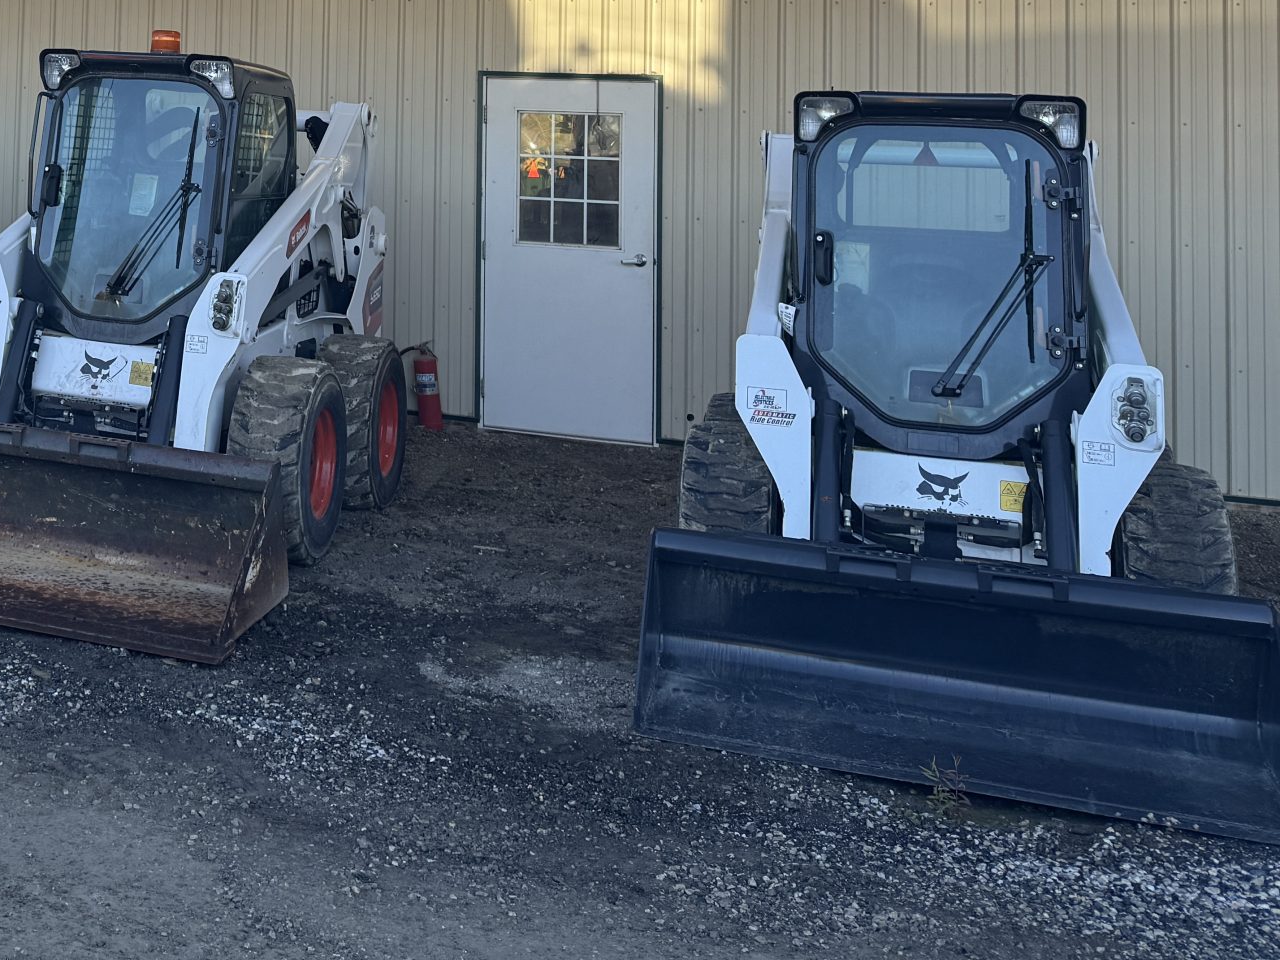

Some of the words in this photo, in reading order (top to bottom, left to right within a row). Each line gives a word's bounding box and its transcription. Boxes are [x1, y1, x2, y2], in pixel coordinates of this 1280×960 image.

[753, 409, 796, 419] AUTOMATIC
[750, 415, 766, 424] Ride
[766, 417, 793, 426] Control
